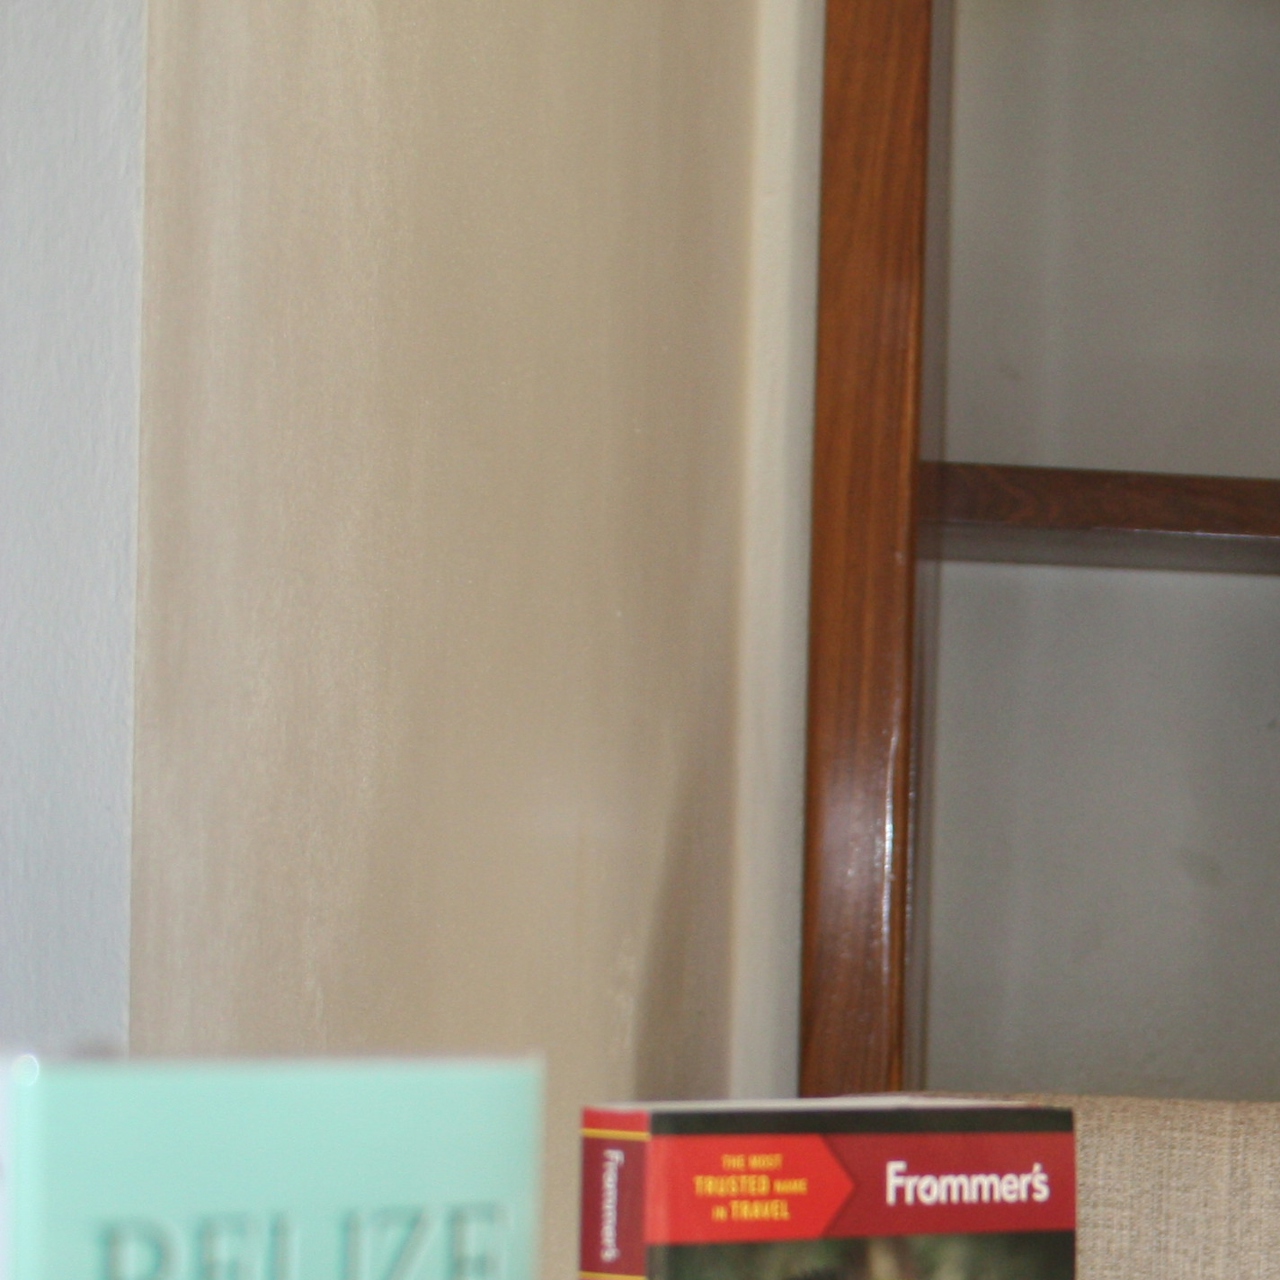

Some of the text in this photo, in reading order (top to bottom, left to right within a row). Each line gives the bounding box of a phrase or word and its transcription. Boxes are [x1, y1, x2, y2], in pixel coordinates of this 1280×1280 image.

[722, 1154, 745, 1170] THE
[694, 1174, 770, 1197] TRUSTED
[886, 1161, 1050, 1206] Frommer's
[730, 1199, 790, 1221] TRAVEL
